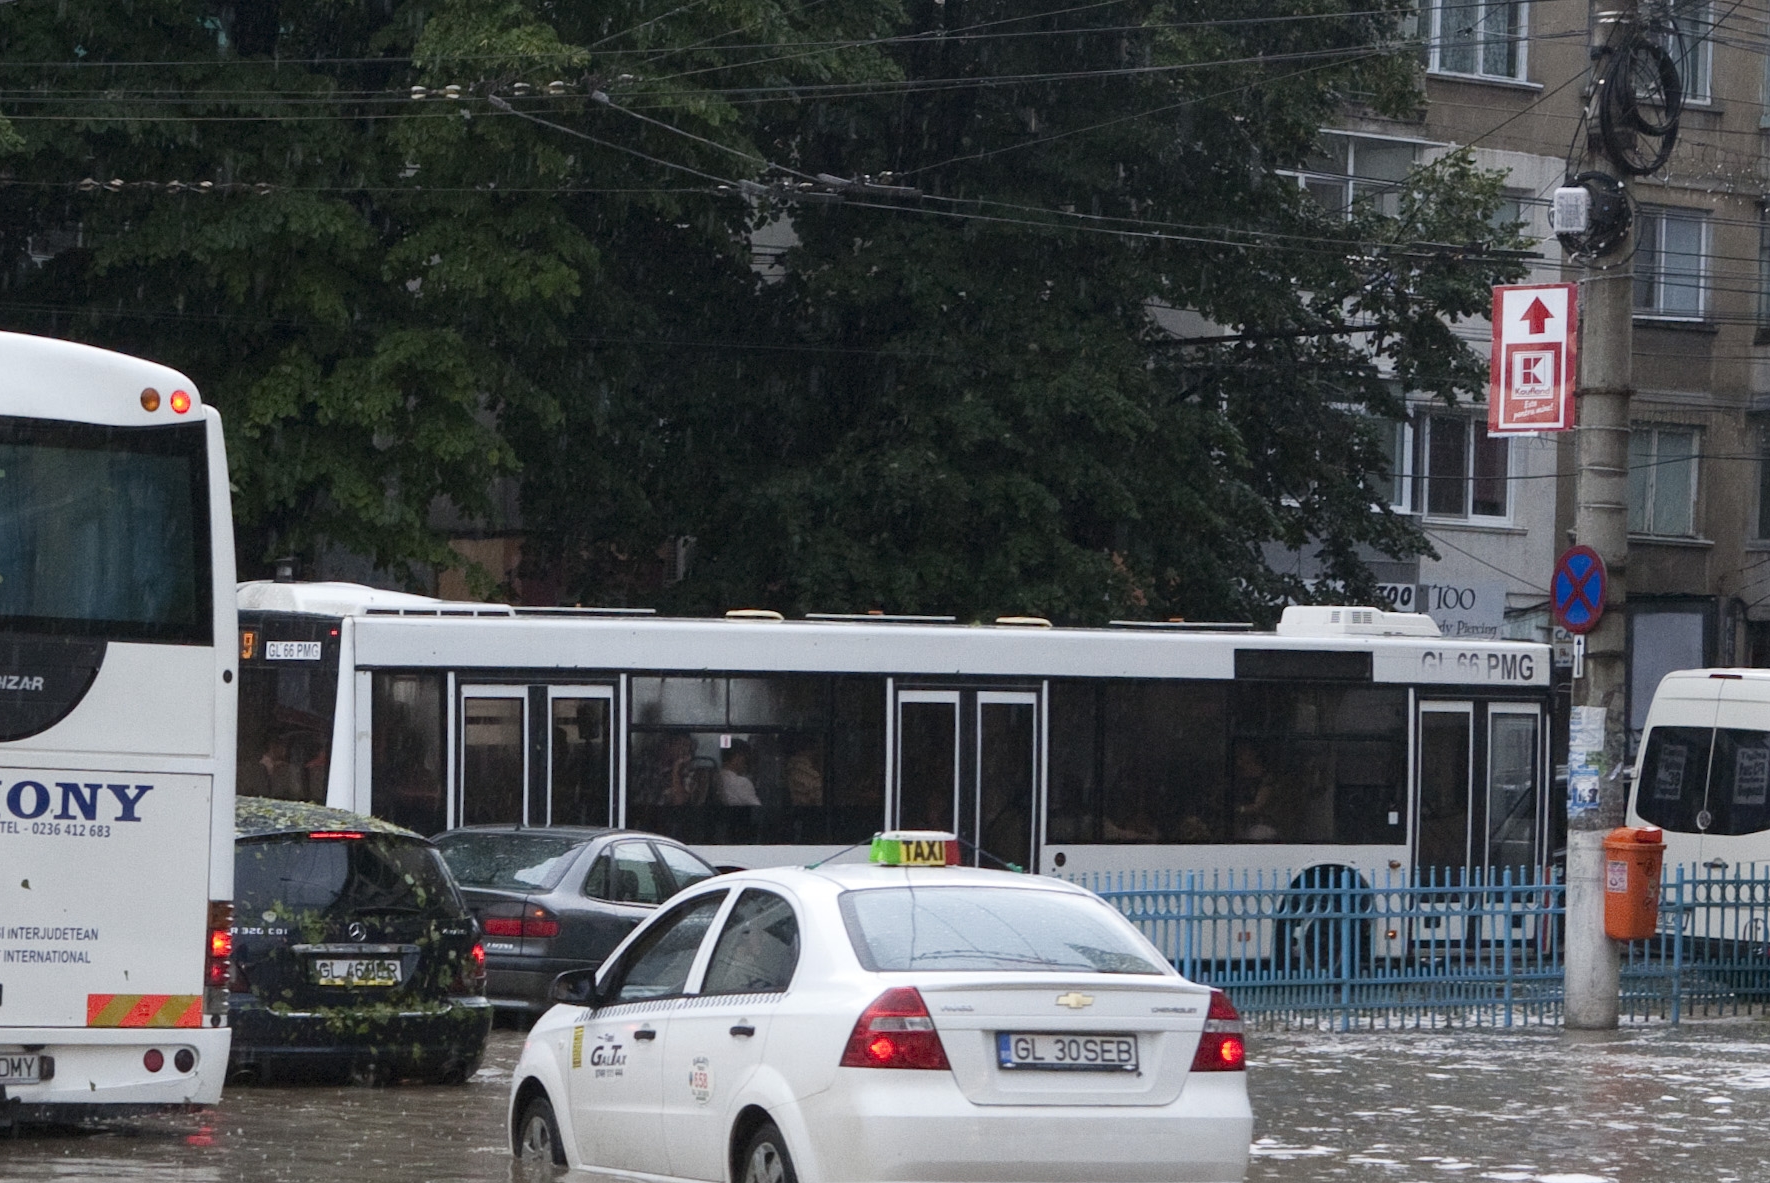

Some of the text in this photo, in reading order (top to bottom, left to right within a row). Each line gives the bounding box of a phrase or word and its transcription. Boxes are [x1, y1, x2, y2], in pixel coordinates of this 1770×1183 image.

[1454, 620, 1498, 639] Piercing
[283, 643, 295, 657] 66
[296, 643, 319, 658] PMG
[1487, 653, 1534, 680] PMG
[0, 820, 20, 834] TEL
[32, 822, 61, 836] 0236
[64, 823, 86, 837] 412
[89, 824, 111, 838] 683
[902, 840, 944, 862] TAXI
[7, 926, 99, 941] INTERJUDETEAN
[3, 949, 92, 964] INTERNATIONAL
[319, 961, 342, 979] GL
[1014, 1038, 1132, 1063] GL 30SEB
